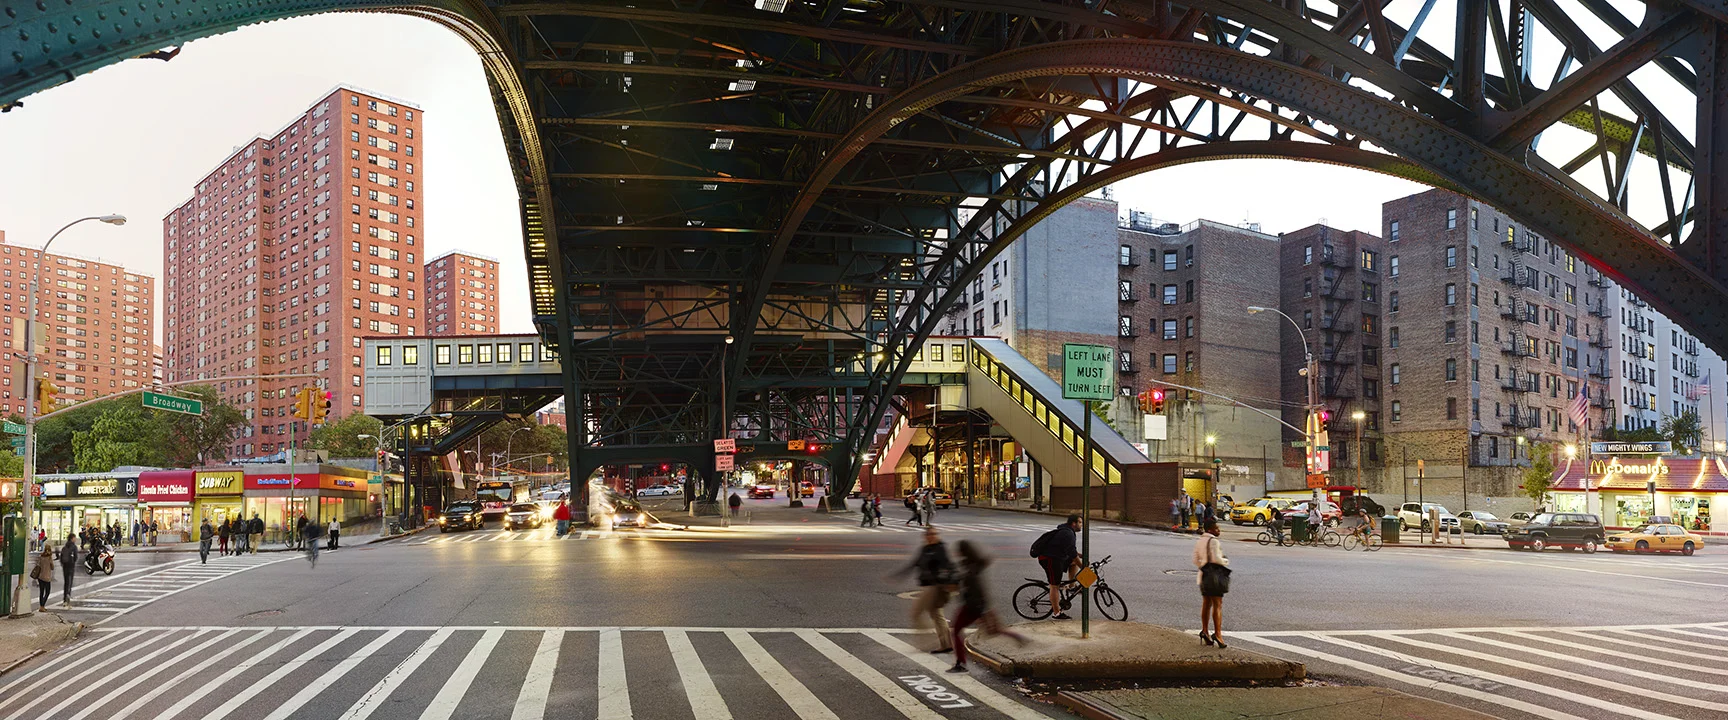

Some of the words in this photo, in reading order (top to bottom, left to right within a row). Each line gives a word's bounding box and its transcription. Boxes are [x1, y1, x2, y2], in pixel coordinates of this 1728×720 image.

[1068, 351, 1088, 360] LEFT
[1092, 352, 1111, 362] LANE
[1077, 366, 1104, 378] MUST
[1068, 383, 1090, 393] TURN
[1093, 384, 1111, 394] LEFT
[152, 396, 192, 412] Broadway
[1594, 444, 1607, 452] NEW
[1608, 444, 1631, 452] MIGHTY
[1631, 444, 1653, 452] WINGS
[1590, 459, 1670, 475] McDonald's
[199, 476, 235, 489] SUBWAY
[140, 485, 157, 495] Lincoln
[157, 485, 169, 495] Fried
[169, 484, 189, 495] Chicken
